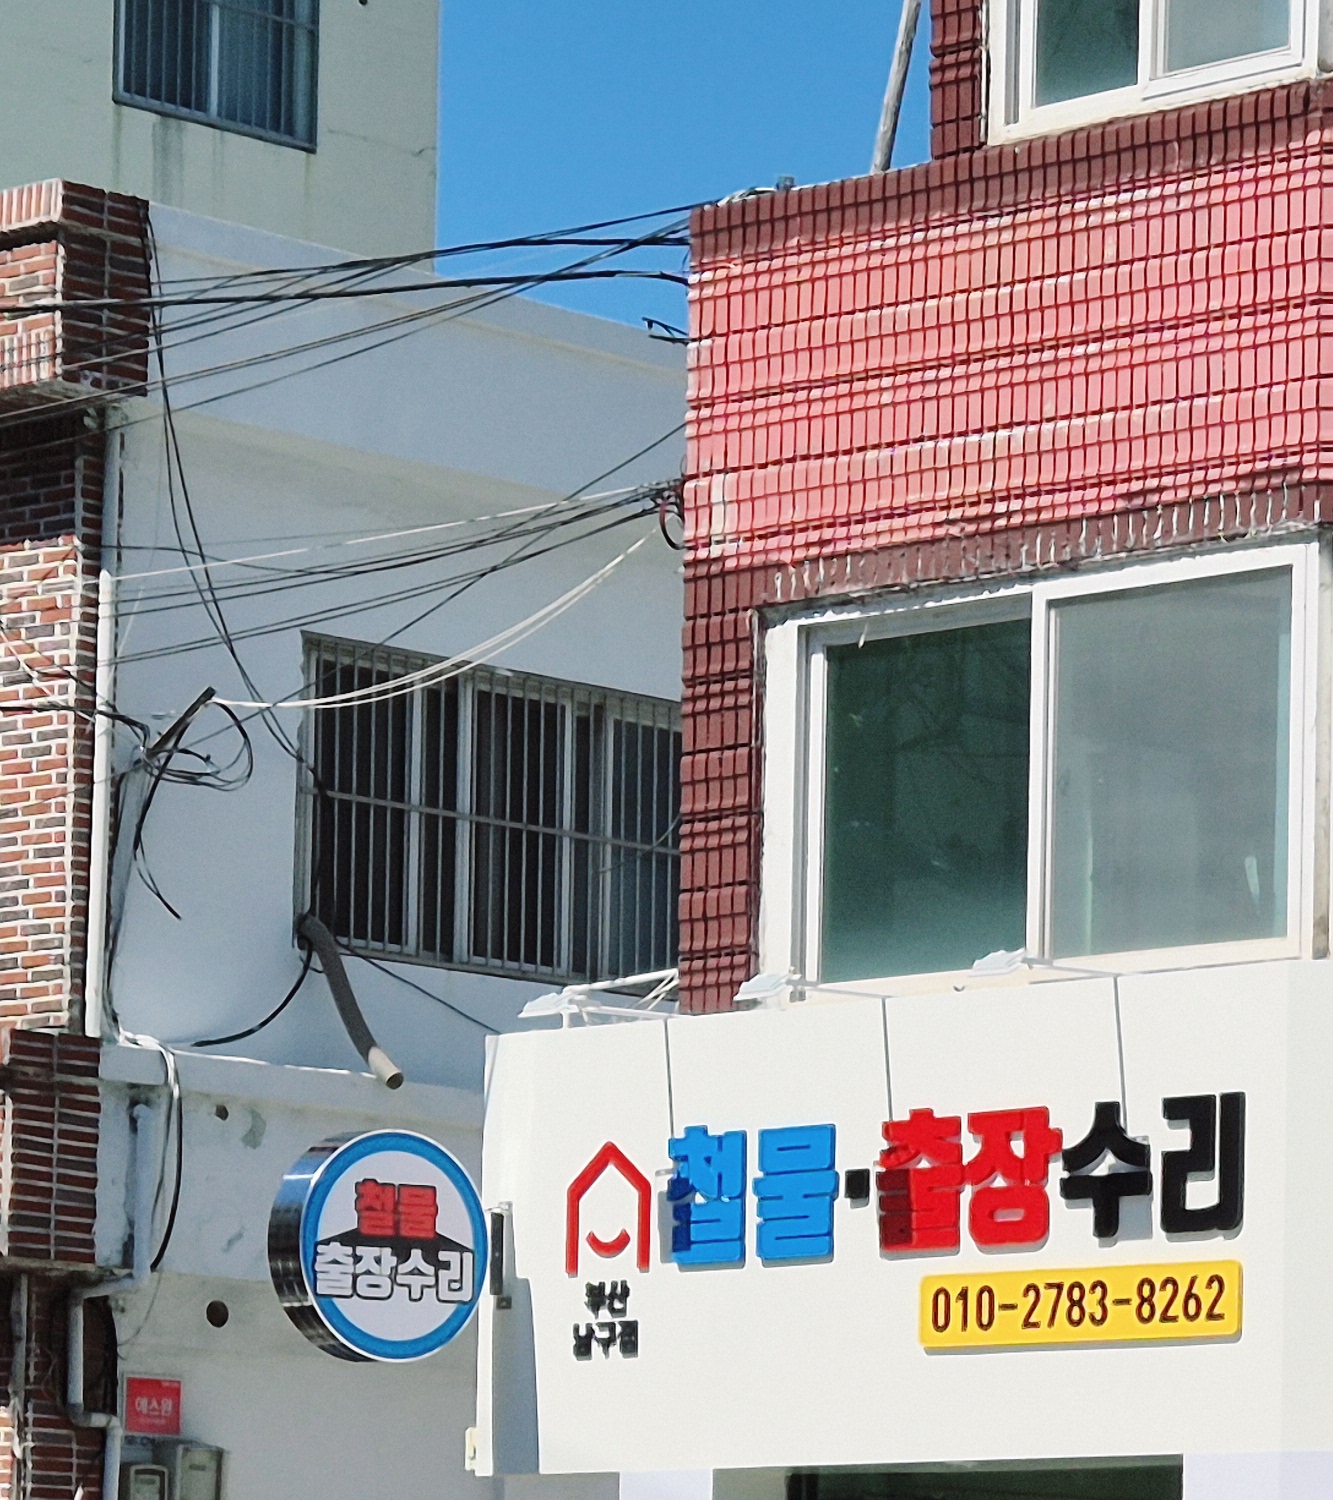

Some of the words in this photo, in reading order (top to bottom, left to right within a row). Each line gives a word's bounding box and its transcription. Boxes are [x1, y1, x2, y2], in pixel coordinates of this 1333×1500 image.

[355, 1178, 438, 1239] 철물
[314, 1241, 475, 1303] 출장수리
[932, 1273, 1226, 1336] 010-2783-8262
